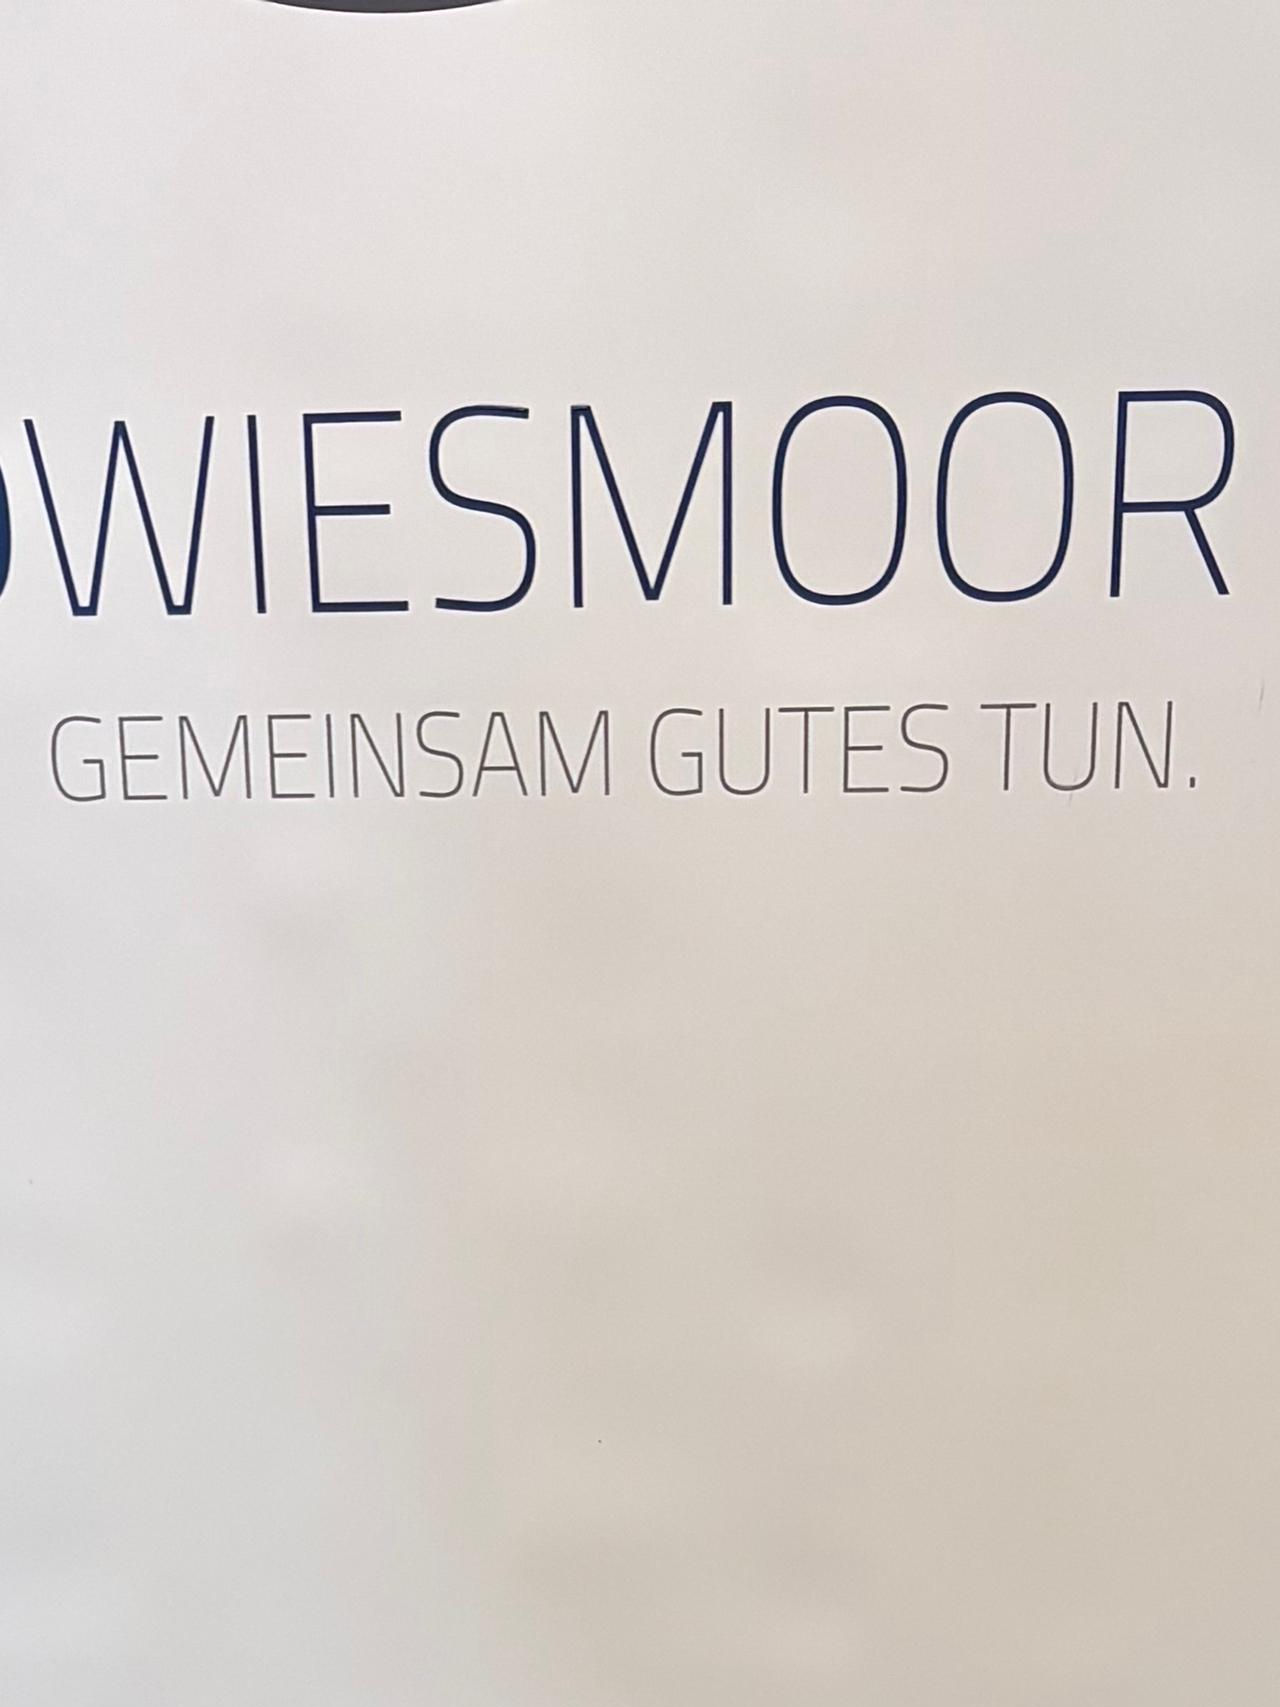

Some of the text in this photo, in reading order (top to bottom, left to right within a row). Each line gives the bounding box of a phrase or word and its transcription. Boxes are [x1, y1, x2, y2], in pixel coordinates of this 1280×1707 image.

[49, 700, 1200, 804] GEMEINSAM GUTES TUN.
